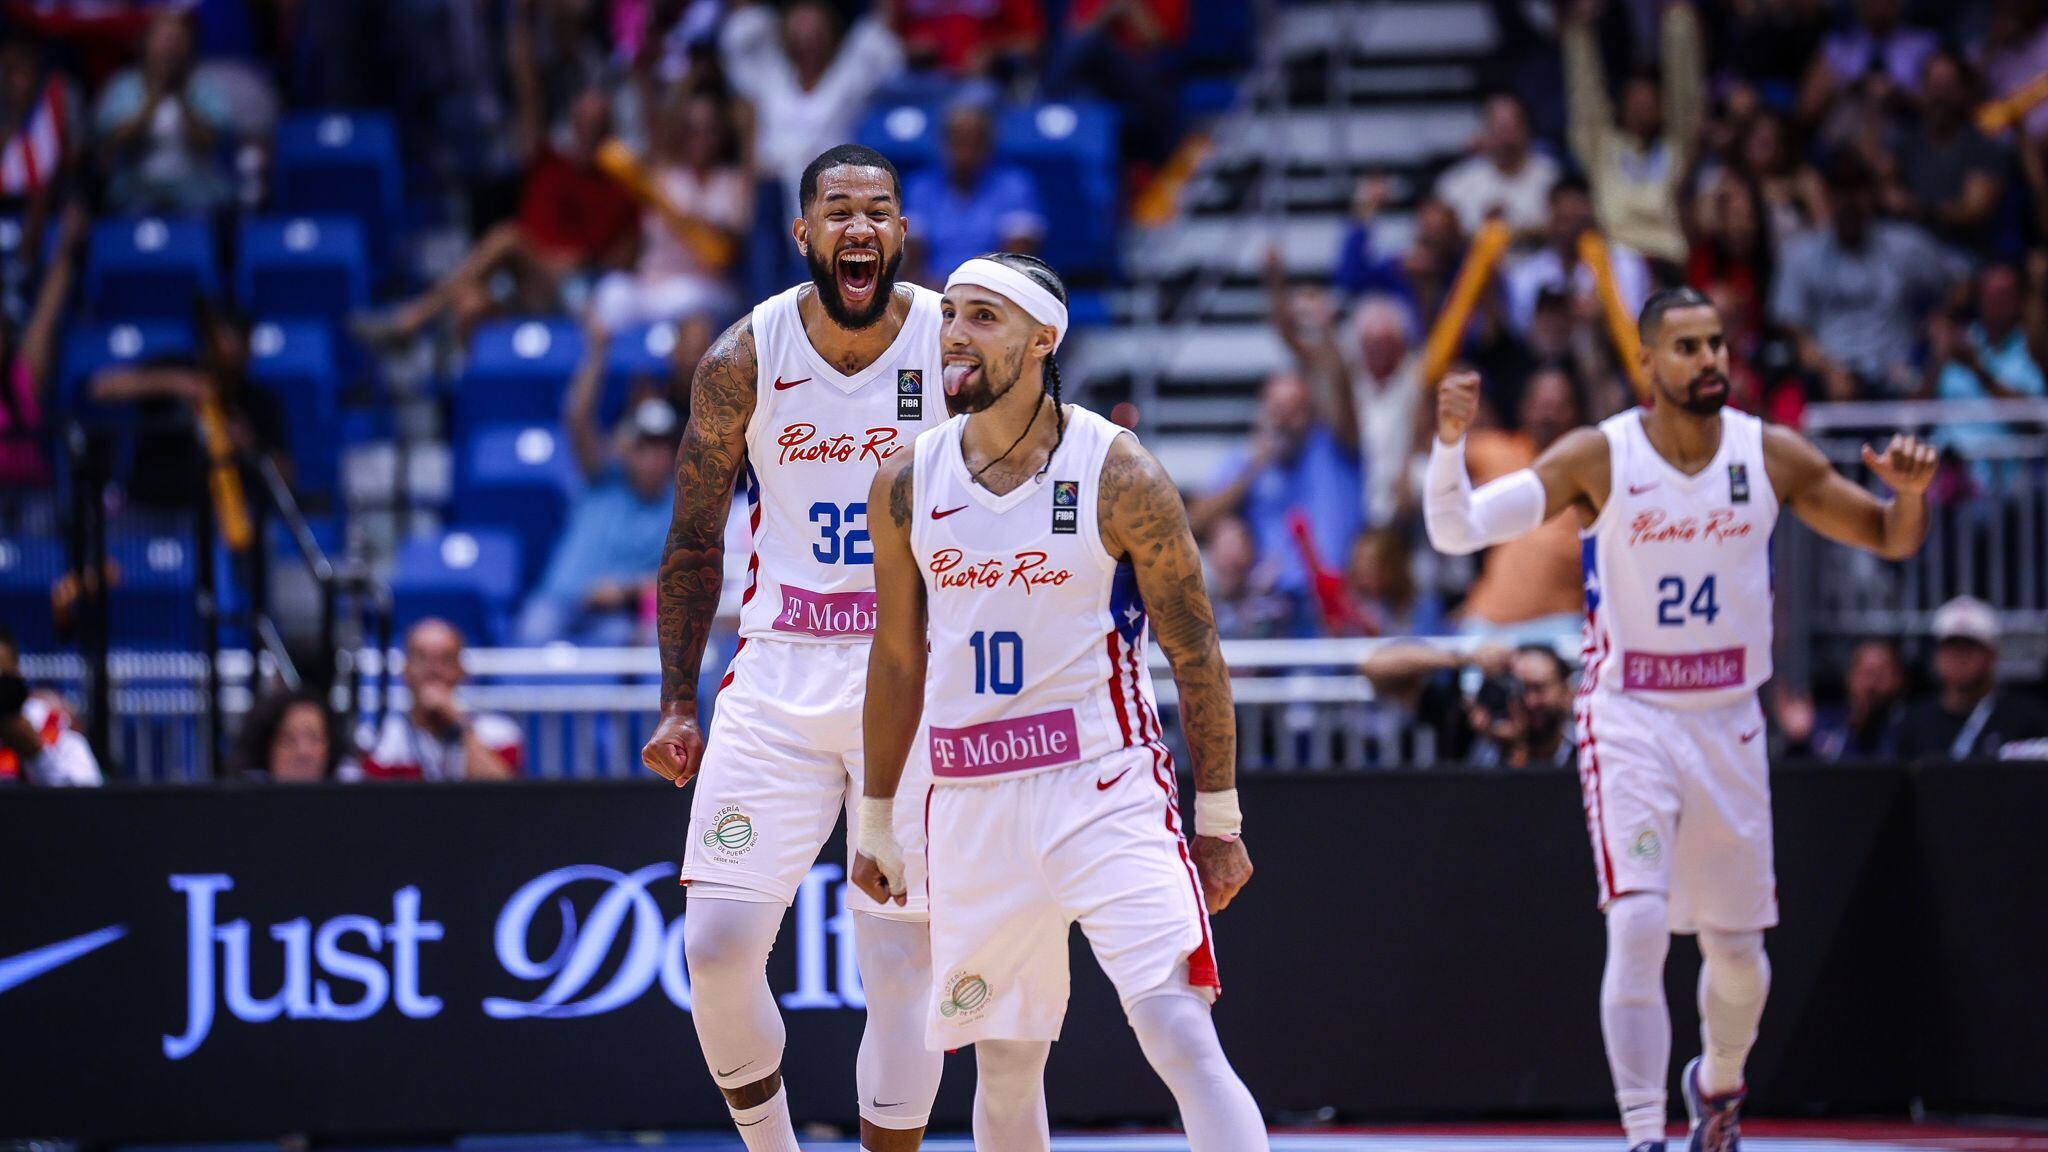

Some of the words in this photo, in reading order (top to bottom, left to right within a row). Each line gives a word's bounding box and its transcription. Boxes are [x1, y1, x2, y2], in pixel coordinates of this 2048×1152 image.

[901, 398, 919, 408] FIBA
[778, 423, 856, 466] Puerto
[859, 427, 904, 467] Ri
[808, 501, 874, 565] 32
[1055, 510, 1075, 521] FIBA
[929, 548, 1004, 592] Puerto
[1008, 551, 1074, 596] Rico
[1657, 574, 1720, 625] 24
[969, 630, 1024, 695] 10
[1656, 654, 1739, 687] Mobile
[959, 724, 1069, 769] Mobile
[162, 872, 446, 1061] Just
